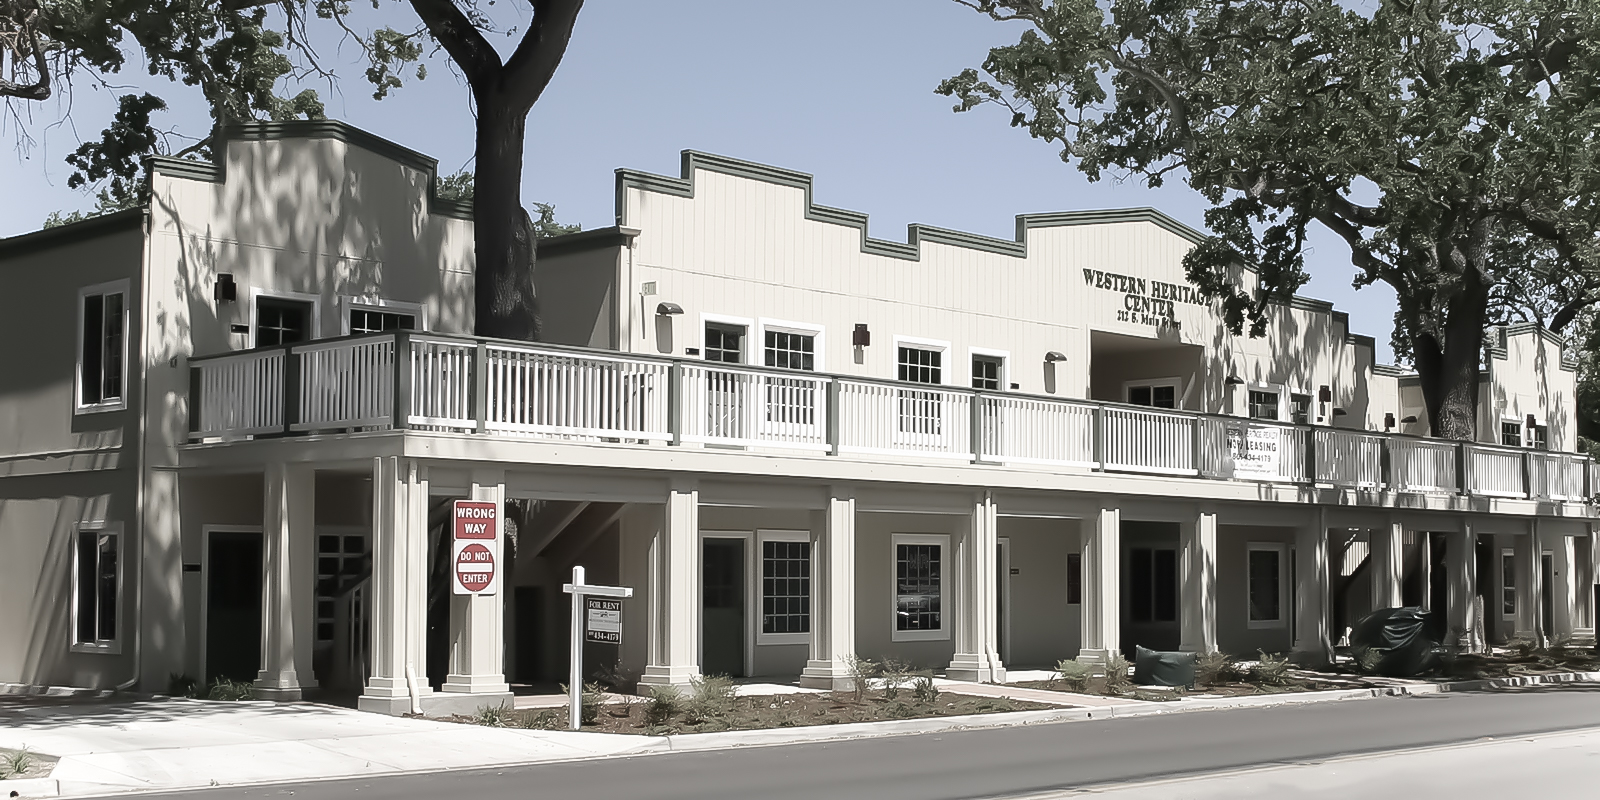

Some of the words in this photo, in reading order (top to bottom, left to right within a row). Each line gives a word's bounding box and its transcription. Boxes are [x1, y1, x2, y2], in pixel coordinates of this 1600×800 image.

[1083, 268, 1146, 295] WESTERN
[1124, 294, 1174, 318] CENTER
[1117, 309, 1129, 322] 212
[1246, 441, 1276, 452] LEASING
[457, 507, 495, 519] WRONG
[464, 523, 487, 534] WAY
[460, 551, 471, 561] DO
[475, 552, 490, 561] NOT
[463, 573, 488, 584] ENTER
[589, 600, 601, 609] FOR
[602, 601, 619, 610] RENT
